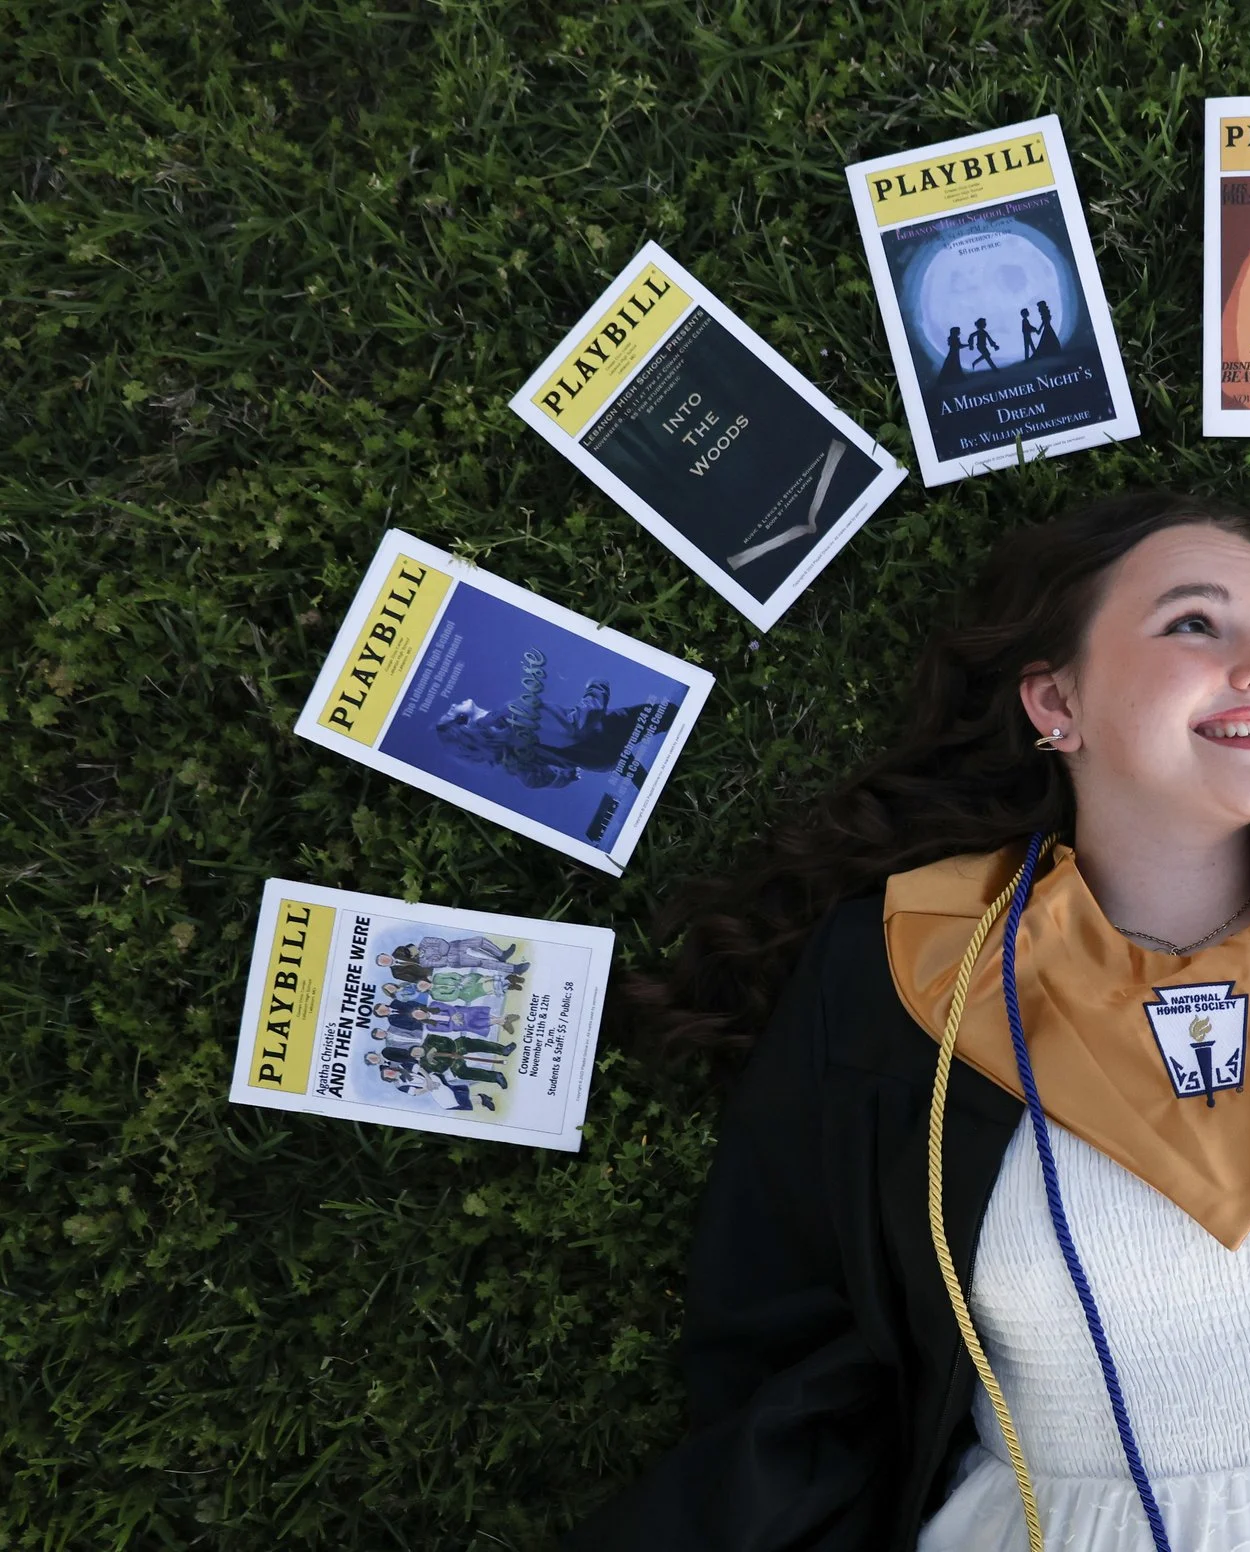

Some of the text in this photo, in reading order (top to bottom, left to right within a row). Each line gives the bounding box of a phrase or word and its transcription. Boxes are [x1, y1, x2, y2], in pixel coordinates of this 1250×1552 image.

[872, 143, 1044, 202] PLAYBILL
[541, 277, 670, 416] PLAYBILL
[582, 408, 617, 446] LEBANON
[616, 385, 637, 407] HIGH
[636, 354, 666, 384] SCHOOL
[665, 309, 703, 351] PRESENTS
[662, 392, 701, 434] INTO
[941, 401, 952, 415] A
[953, 383, 1035, 411] MIDSUMMER
[996, 403, 1045, 423] DREAM
[681, 410, 719, 445] THE
[689, 414, 748, 475] WOODS
[959, 411, 1088, 449] BY: WILLIAM SHAKESPEARE
[328, 567, 426, 731] PLAYBILL
[258, 905, 310, 1084] PLAYBILL
[539, 994, 550, 1011] 12th
[559, 992, 571, 1017] Public:
[563, 981, 573, 991] $8
[1171, 994, 1220, 1004] NATIONAL
[328, 915, 370, 1098] AND THEN THERE WERE
[355, 982, 376, 1029] NONE
[1156, 1001, 1237, 1016] HONOR SOCIETY
[517, 993, 539, 1074] Cowan Civic Center
[535, 1020, 545, 1037] 11th
[544, 1027, 555, 1047] 7p.m.
[556, 1024, 566, 1033] $5
[315, 1022, 336, 1095] Agatha Christie's
[529, 1038, 542, 1077] November
[546, 1063, 560, 1096] Students
